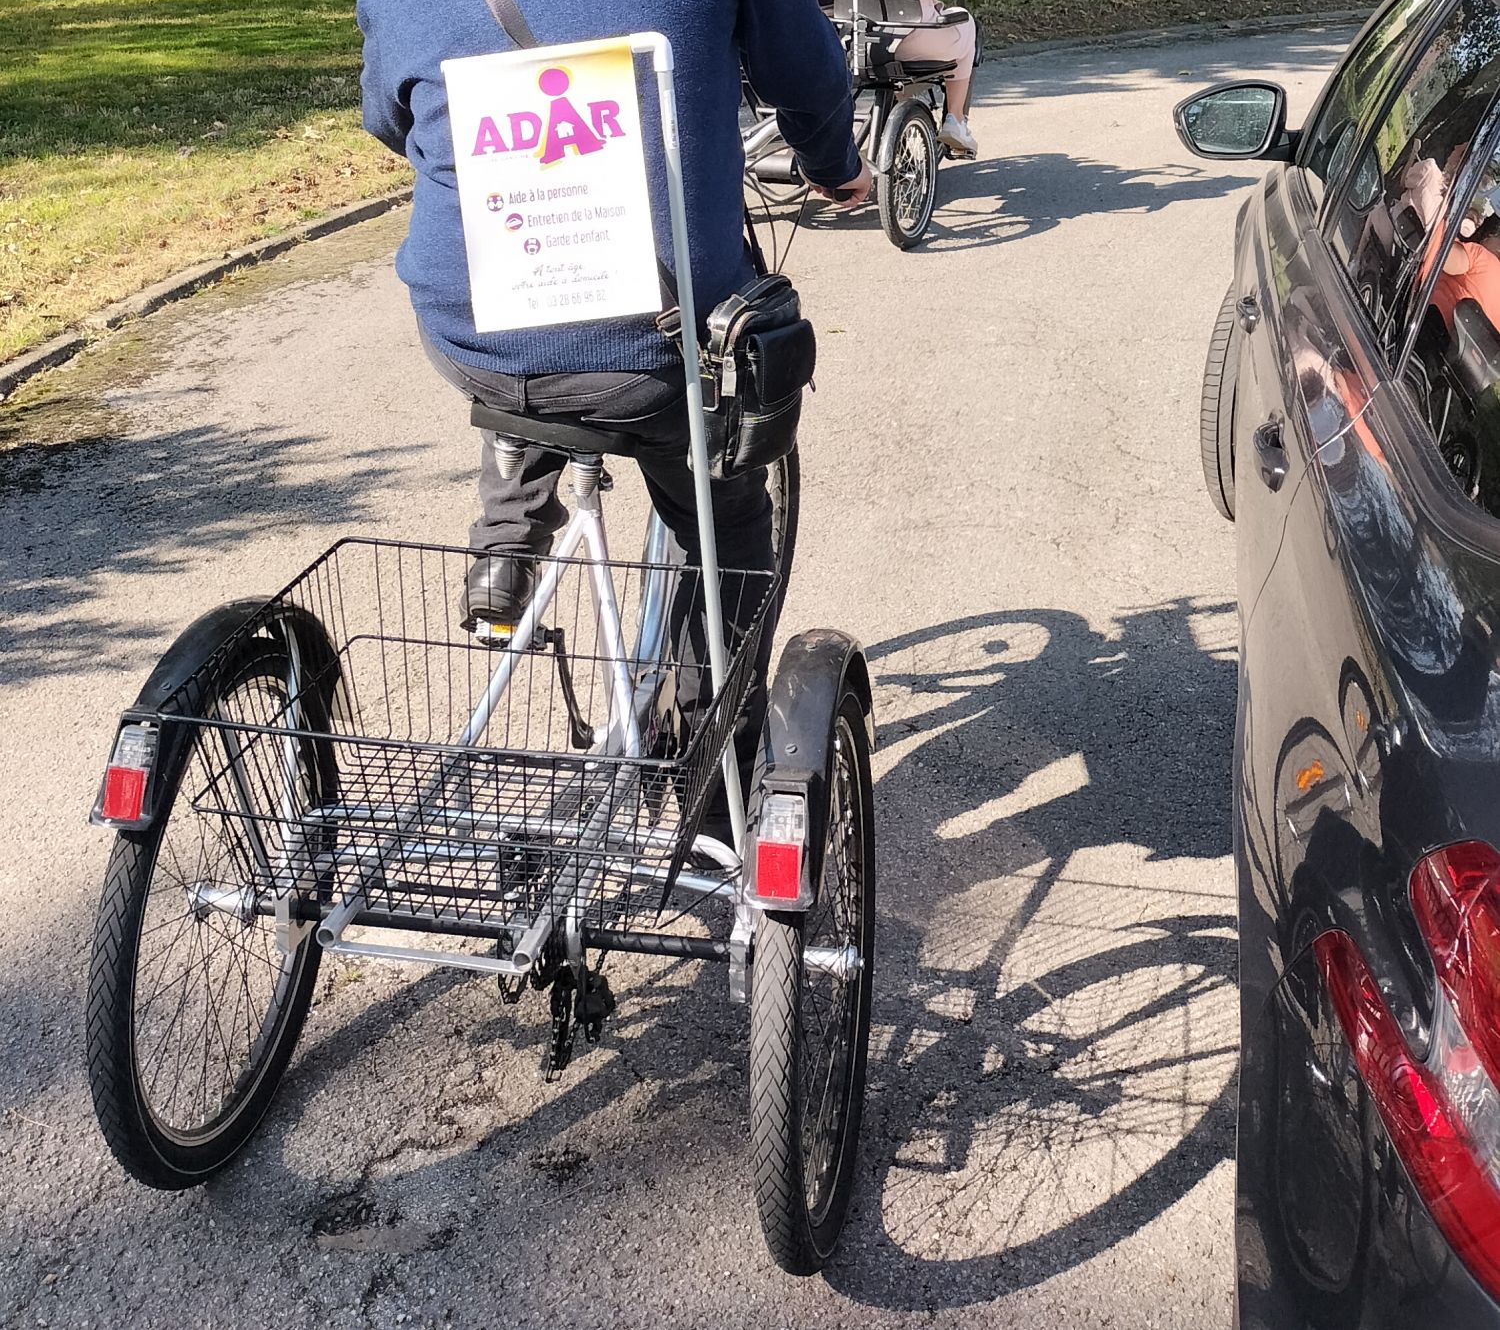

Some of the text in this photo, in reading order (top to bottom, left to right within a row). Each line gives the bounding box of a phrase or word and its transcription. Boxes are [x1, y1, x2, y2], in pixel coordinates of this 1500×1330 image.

[471, 95, 626, 165] ADAR
[509, 184, 589, 205] Aide à la personne
[528, 205, 626, 228] Entretien de la Maison
[546, 235, 571, 248] Garde
[560, 294, 570, 306] 28
